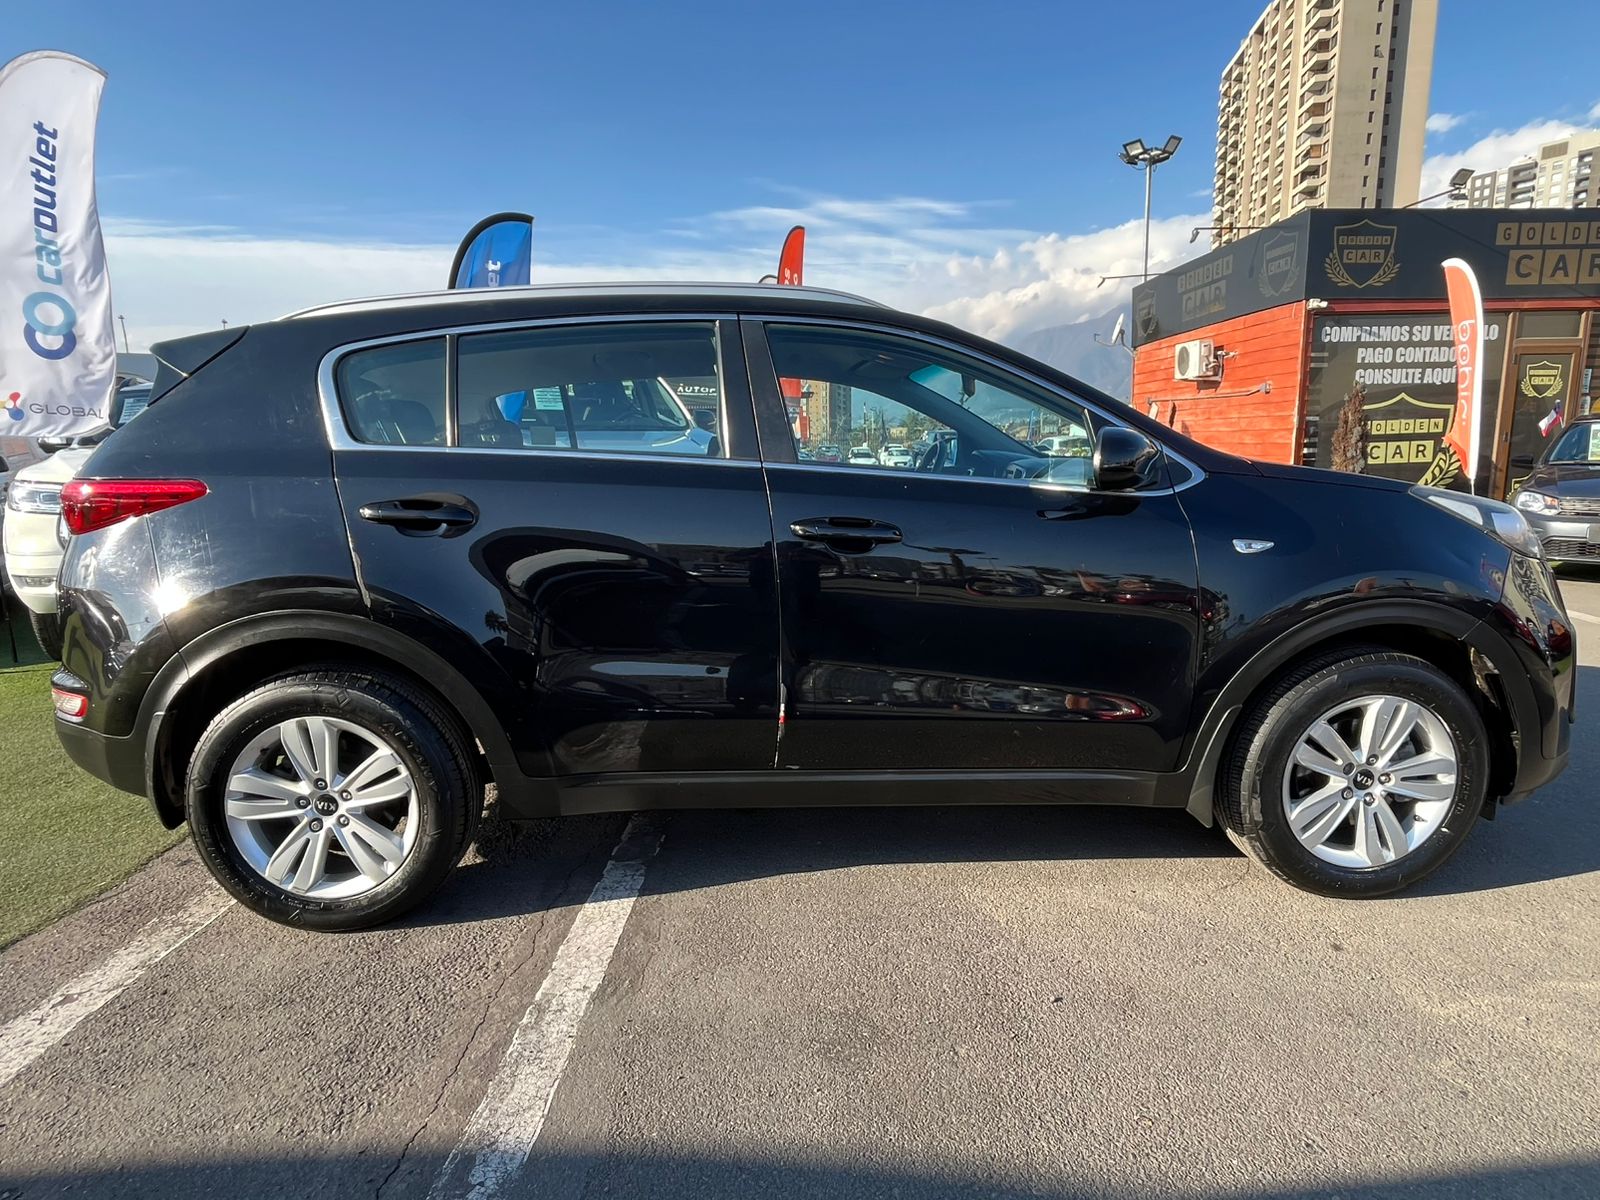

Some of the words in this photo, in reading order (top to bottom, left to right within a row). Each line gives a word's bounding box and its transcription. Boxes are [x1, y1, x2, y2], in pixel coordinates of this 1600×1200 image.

[29, 120, 64, 285] caroutlet
[1345, 250, 1384, 262] CAR
[1514, 253, 1600, 279] CAR
[1321, 325, 1410, 343] COMPRAMOS
[1411, 325, 1432, 342] SU
[1433, 324, 1499, 341] VELO
[1357, 347, 1393, 364] PAGO
[1395, 346, 1457, 363] CONTADO
[1355, 368, 1422, 385] CONSULTE
[1422, 366, 1457, 384] AQUÍ
[29, 403, 104, 419] GLOBAL
[1367, 421, 1442, 433] OLDEN
[1368, 443, 1429, 461] CAR
[316, 800, 337, 811] KIA
